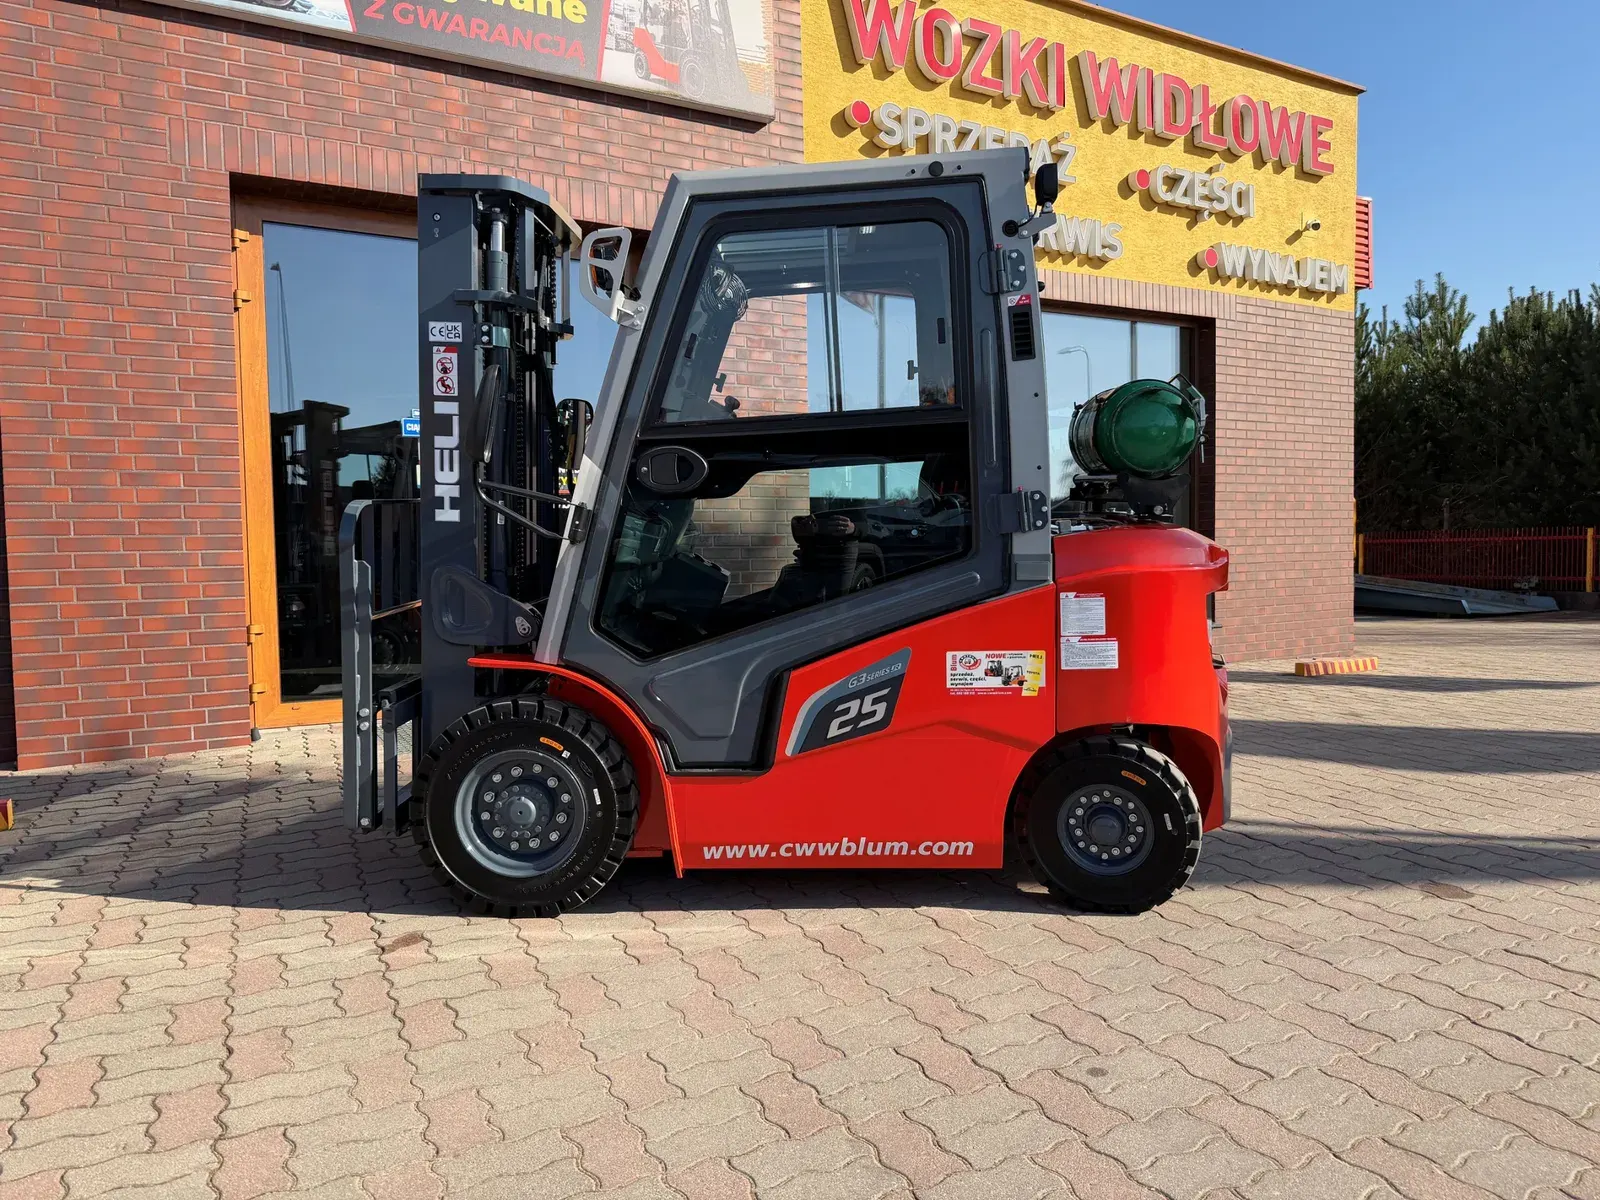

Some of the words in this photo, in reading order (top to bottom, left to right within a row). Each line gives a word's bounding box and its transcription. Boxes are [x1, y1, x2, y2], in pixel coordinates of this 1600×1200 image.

[392, 3, 586, 68] GWARANCJĄ
[1078, 50, 1334, 176] WIDŁOWE
[1150, 163, 1255, 222] CZĘŚCI
[1217, 242, 1348, 294] WYNAJEM
[433, 401, 461, 523] HELI
[848, 673, 867, 689] G3
[866, 667, 890, 682] SERIES
[826, 687, 891, 739] 25
[703, 837, 974, 860] www.cwwblum.com
